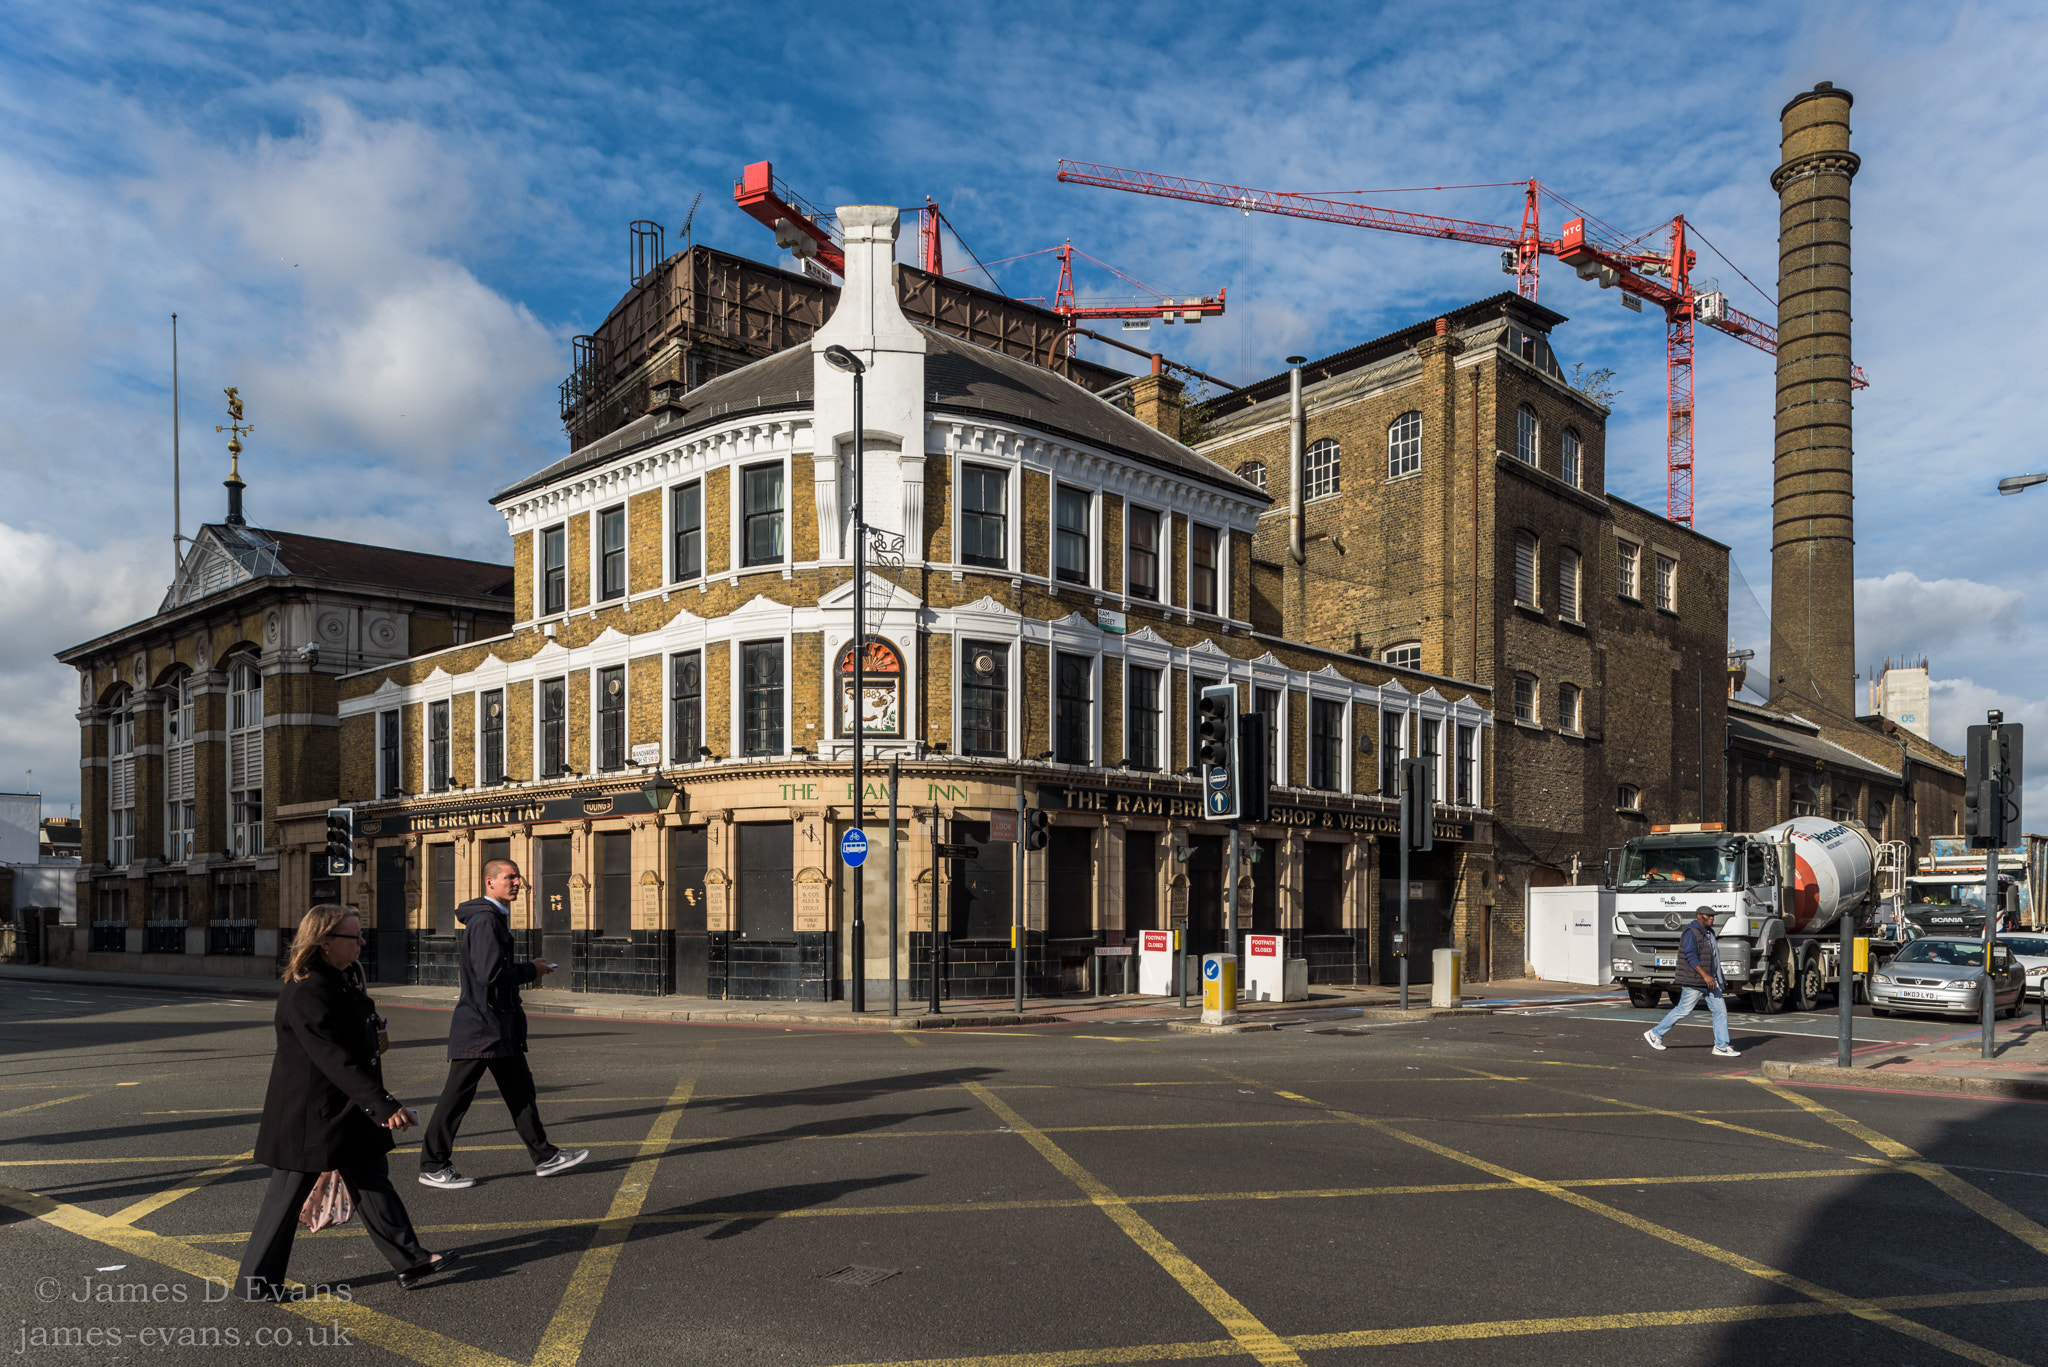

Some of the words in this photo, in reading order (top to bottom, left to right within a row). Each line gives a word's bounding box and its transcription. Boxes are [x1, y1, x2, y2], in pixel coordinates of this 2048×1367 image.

[1563, 224, 1581, 237] HTC
[1099, 610, 1109, 618] RAM
[1098, 617, 1115, 625] STREET
[779, 783, 819, 800] THE
[927, 783, 968, 802] INN
[409, 813, 435, 831] THE
[438, 806, 511, 828] BREWERY
[517, 802, 546, 821] TAP
[1063, 790, 1109, 811] THE
[1116, 794, 1163, 815] RAM
[1271, 807, 1316, 826] SHOP
[1322, 812, 1333, 828] &
[1432, 823, 1463, 839] NTRE
[996, 822, 1012, 830] LOOK
[1811, 825, 1850, 844] Hanson
[1903, 990, 1920, 998] BK03
